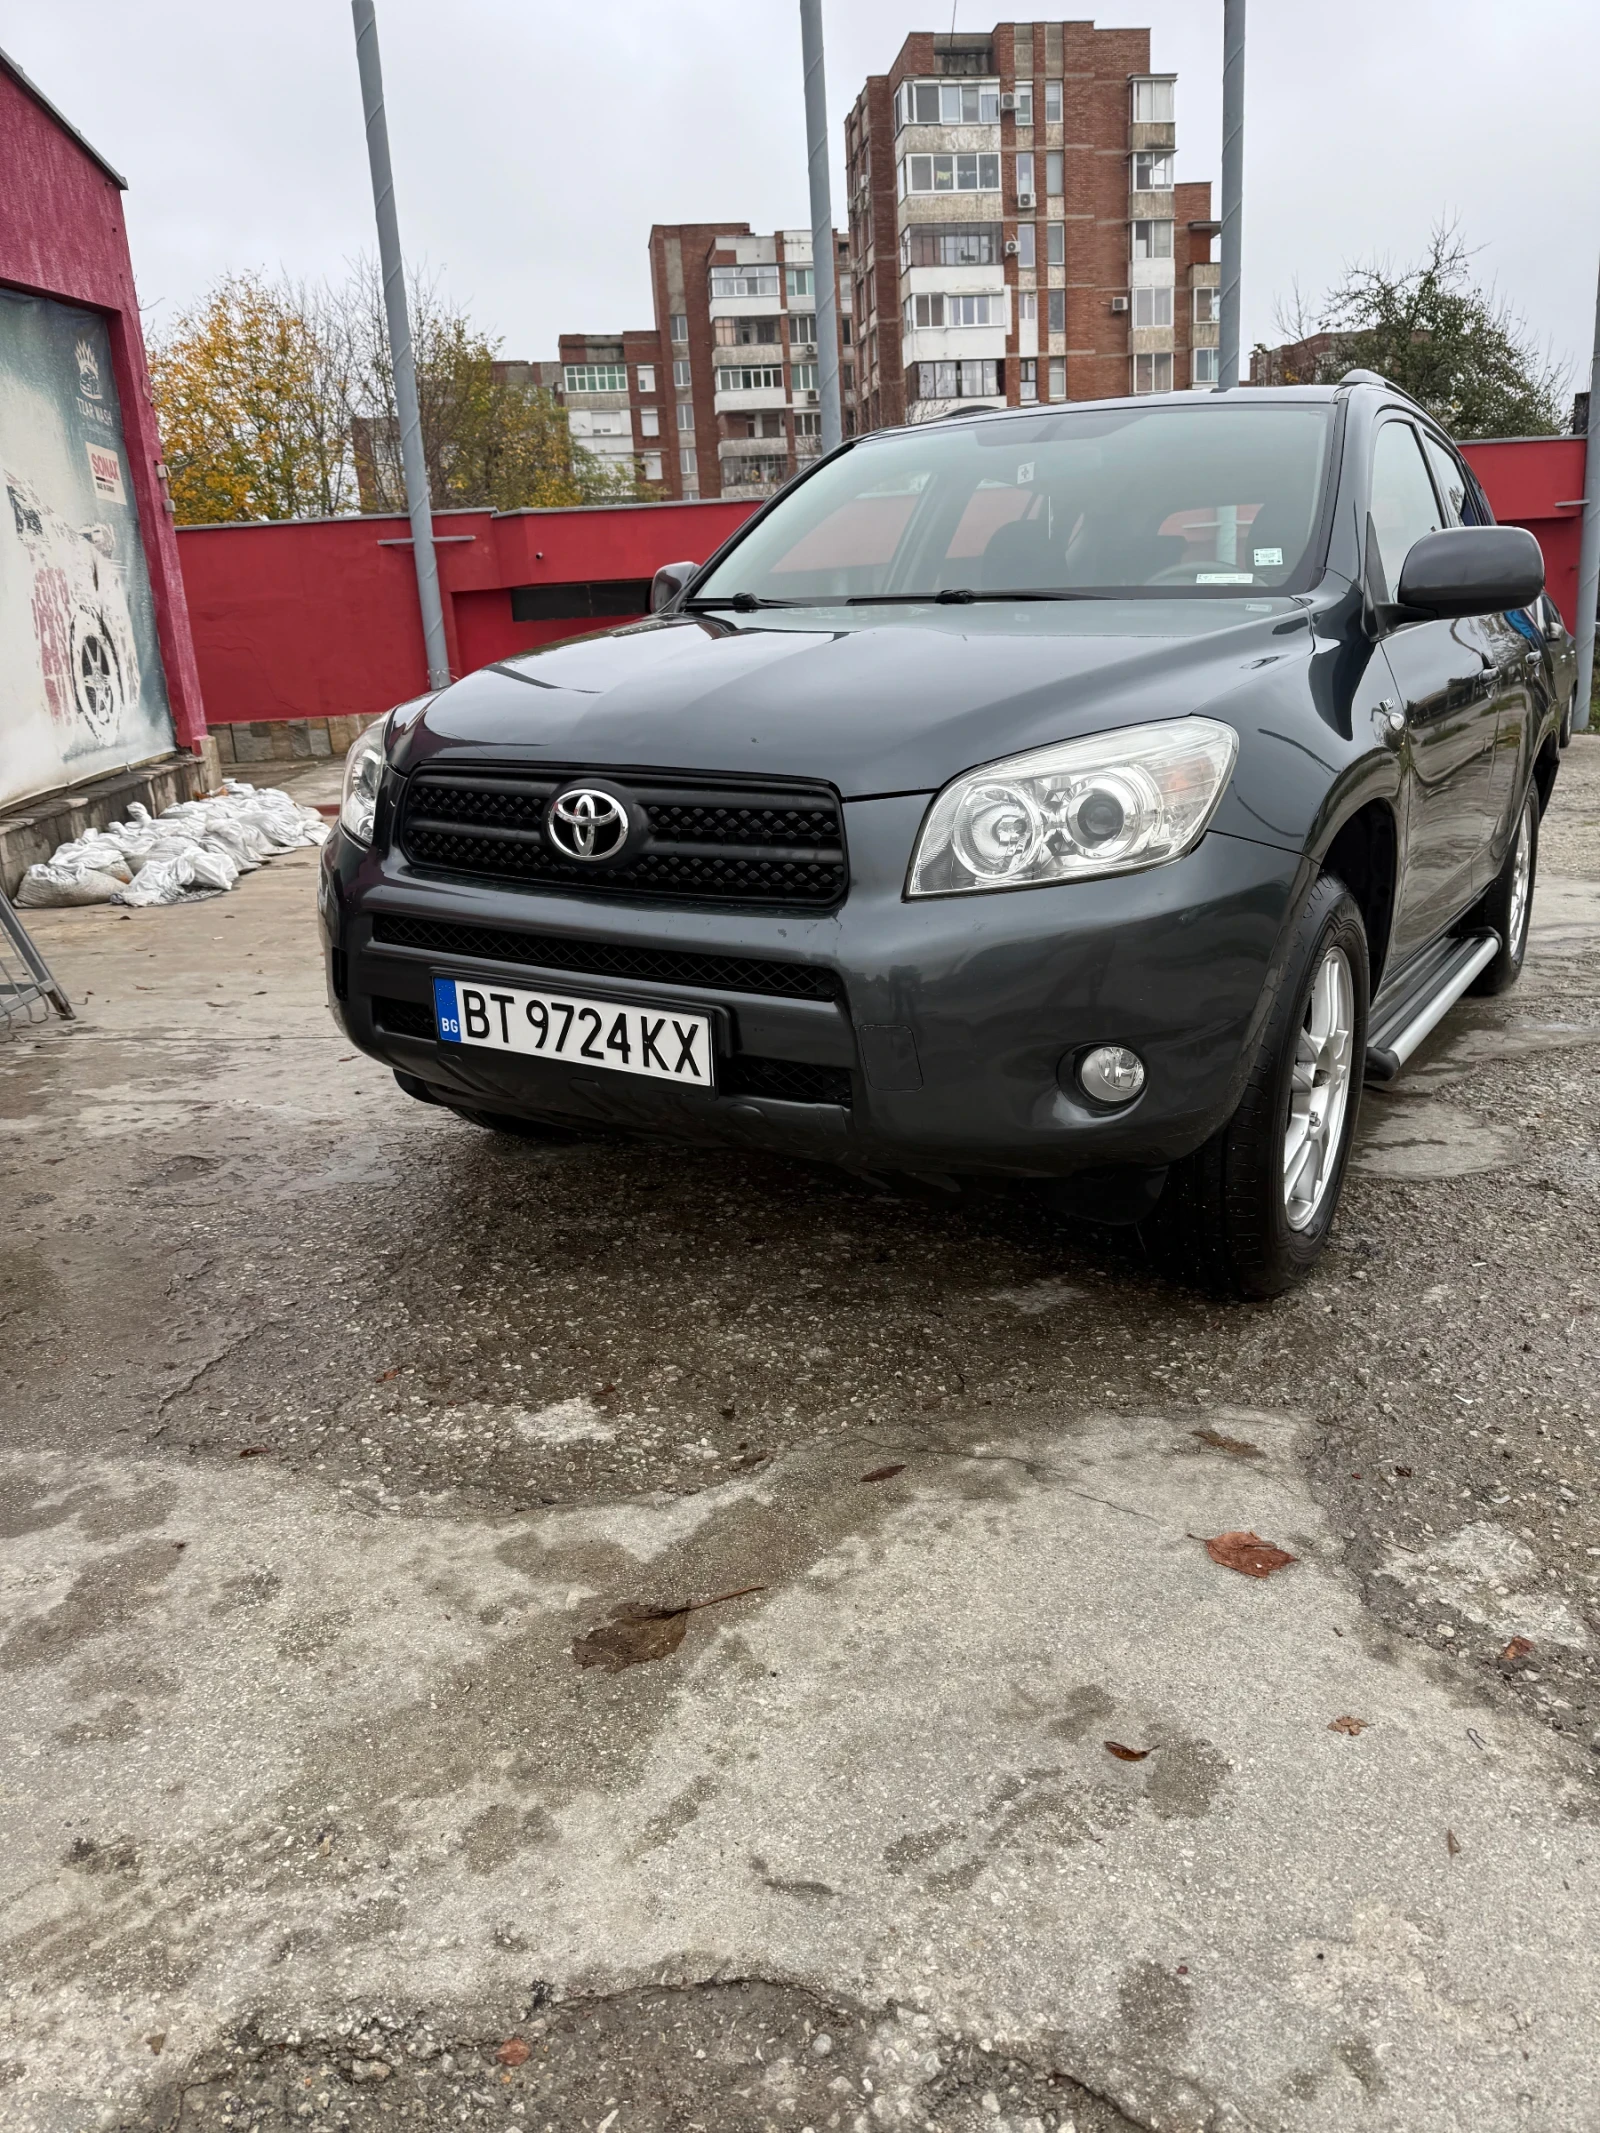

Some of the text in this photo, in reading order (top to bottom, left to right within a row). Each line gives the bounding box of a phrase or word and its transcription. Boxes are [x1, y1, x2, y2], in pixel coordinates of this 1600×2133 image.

[91, 452, 120, 481] SONAX
[441, 1016, 459, 1034] BG
[462, 988, 702, 1078] BT 9724 KX
